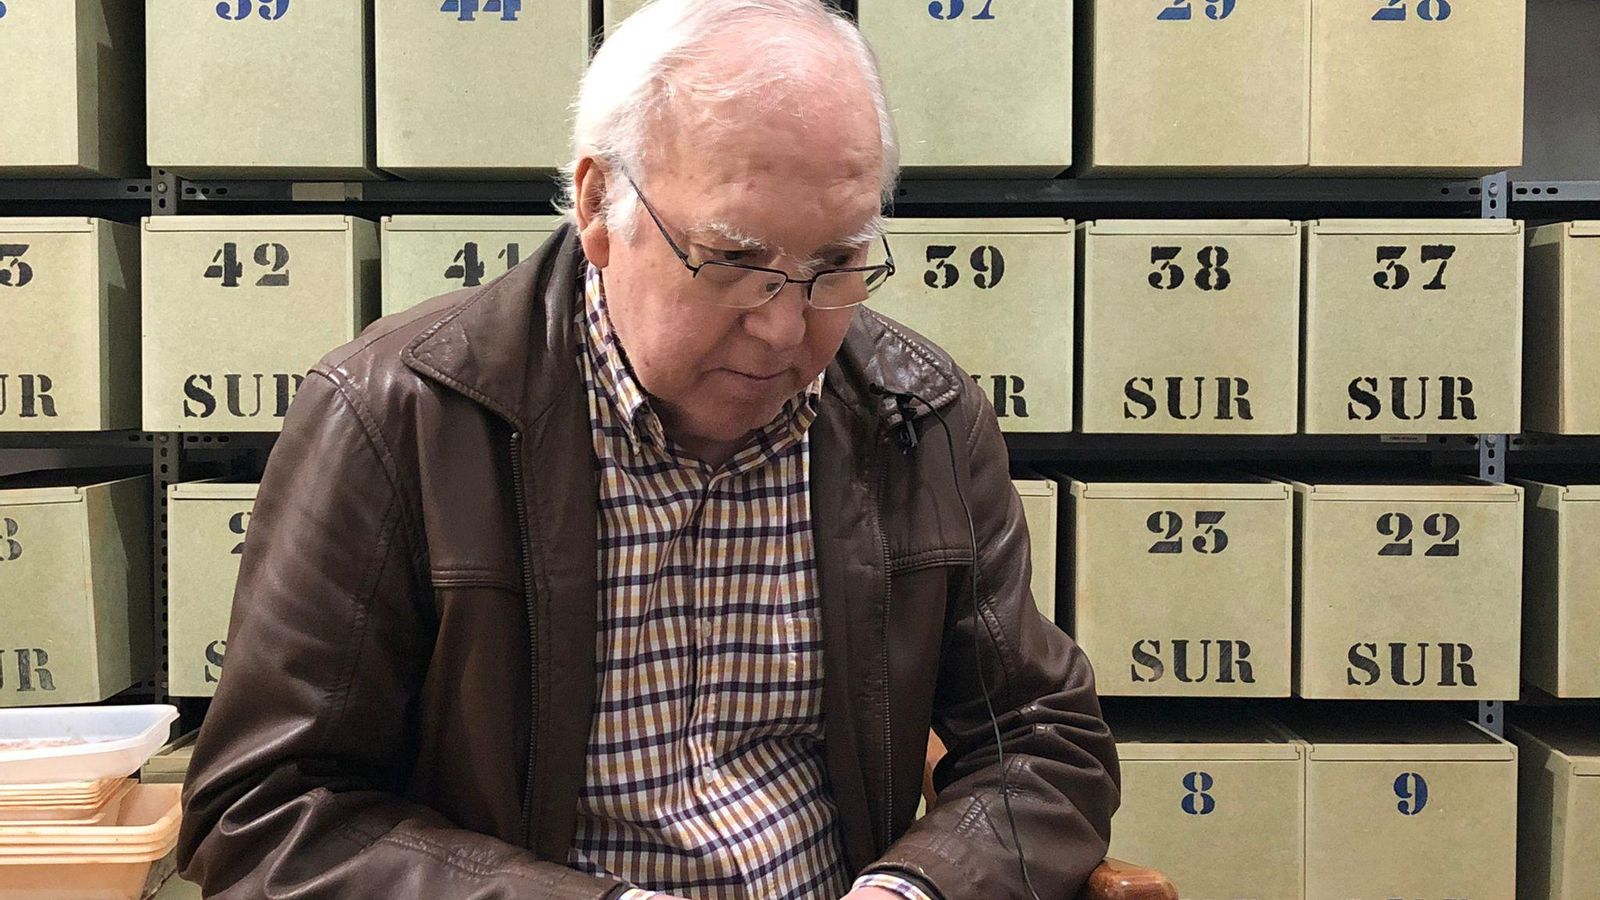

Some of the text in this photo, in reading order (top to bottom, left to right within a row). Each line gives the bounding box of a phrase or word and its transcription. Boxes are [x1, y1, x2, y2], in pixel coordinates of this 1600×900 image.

[204, 243, 290, 287] 42
[924, 245, 1005, 289] 39
[1148, 246, 1232, 291] 38
[1373, 244, 1456, 290] 37
[1124, 376, 1254, 421] SUR
[1348, 376, 1477, 421] SUR
[1147, 511, 1229, 554] 23
[1376, 513, 1460, 556] 22
[1131, 639, 1255, 683] SUR
[1347, 642, 1477, 686] SUR
[1181, 771, 1216, 815] 8
[1393, 772, 1429, 815] 9
